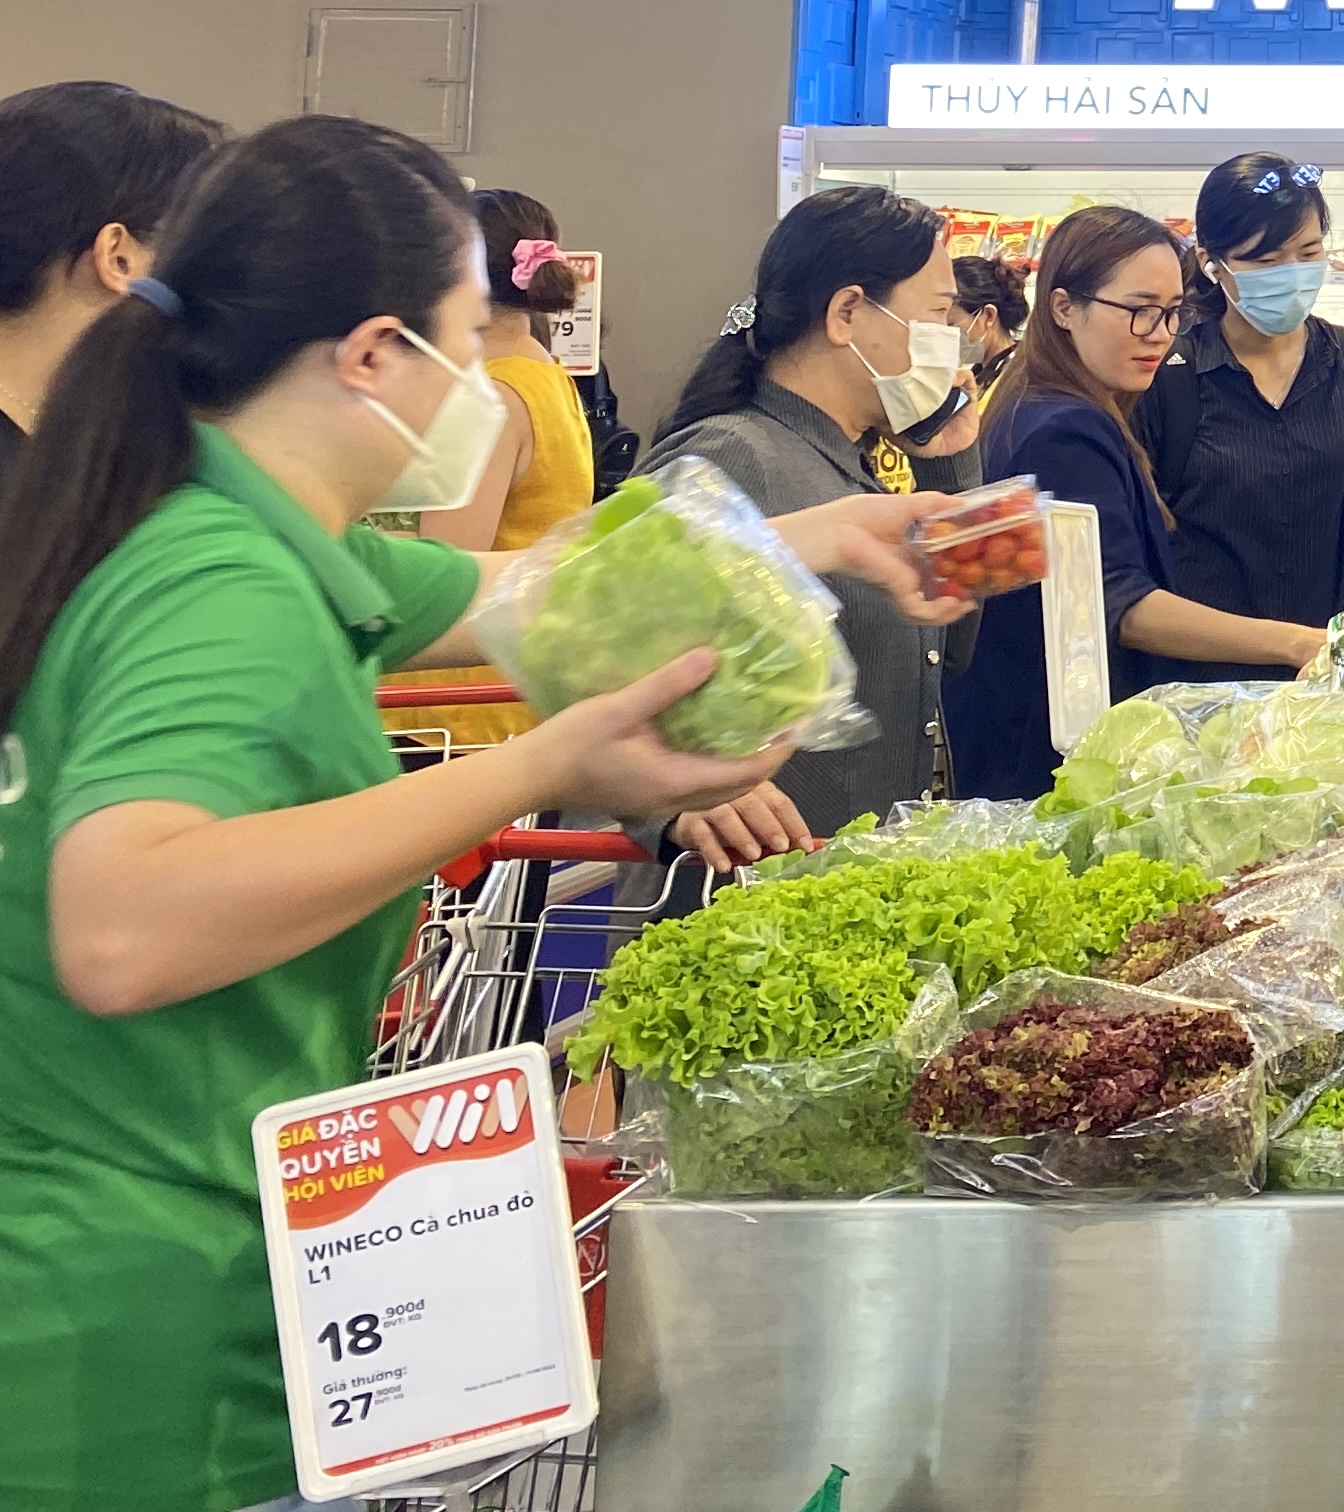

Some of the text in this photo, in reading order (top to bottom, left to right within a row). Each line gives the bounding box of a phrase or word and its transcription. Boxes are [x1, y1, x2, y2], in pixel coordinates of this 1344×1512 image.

[1045, 76, 1111, 114] HẢI
[1128, 76, 1209, 115] SẢN
[277, 1108, 379, 1149] GIÁ ĐẶC
[280, 1136, 381, 1180] QUYỀN
[283, 1164, 386, 1204] HỘI VIÊN
[304, 1190, 535, 1263] WINECO Cà chua đỏ
[308, 1265, 332, 1285] L1
[317, 1313, 382, 1363] 18
[323, 1366, 408, 1395] Giá thường:
[328, 1391, 374, 1428] 27
